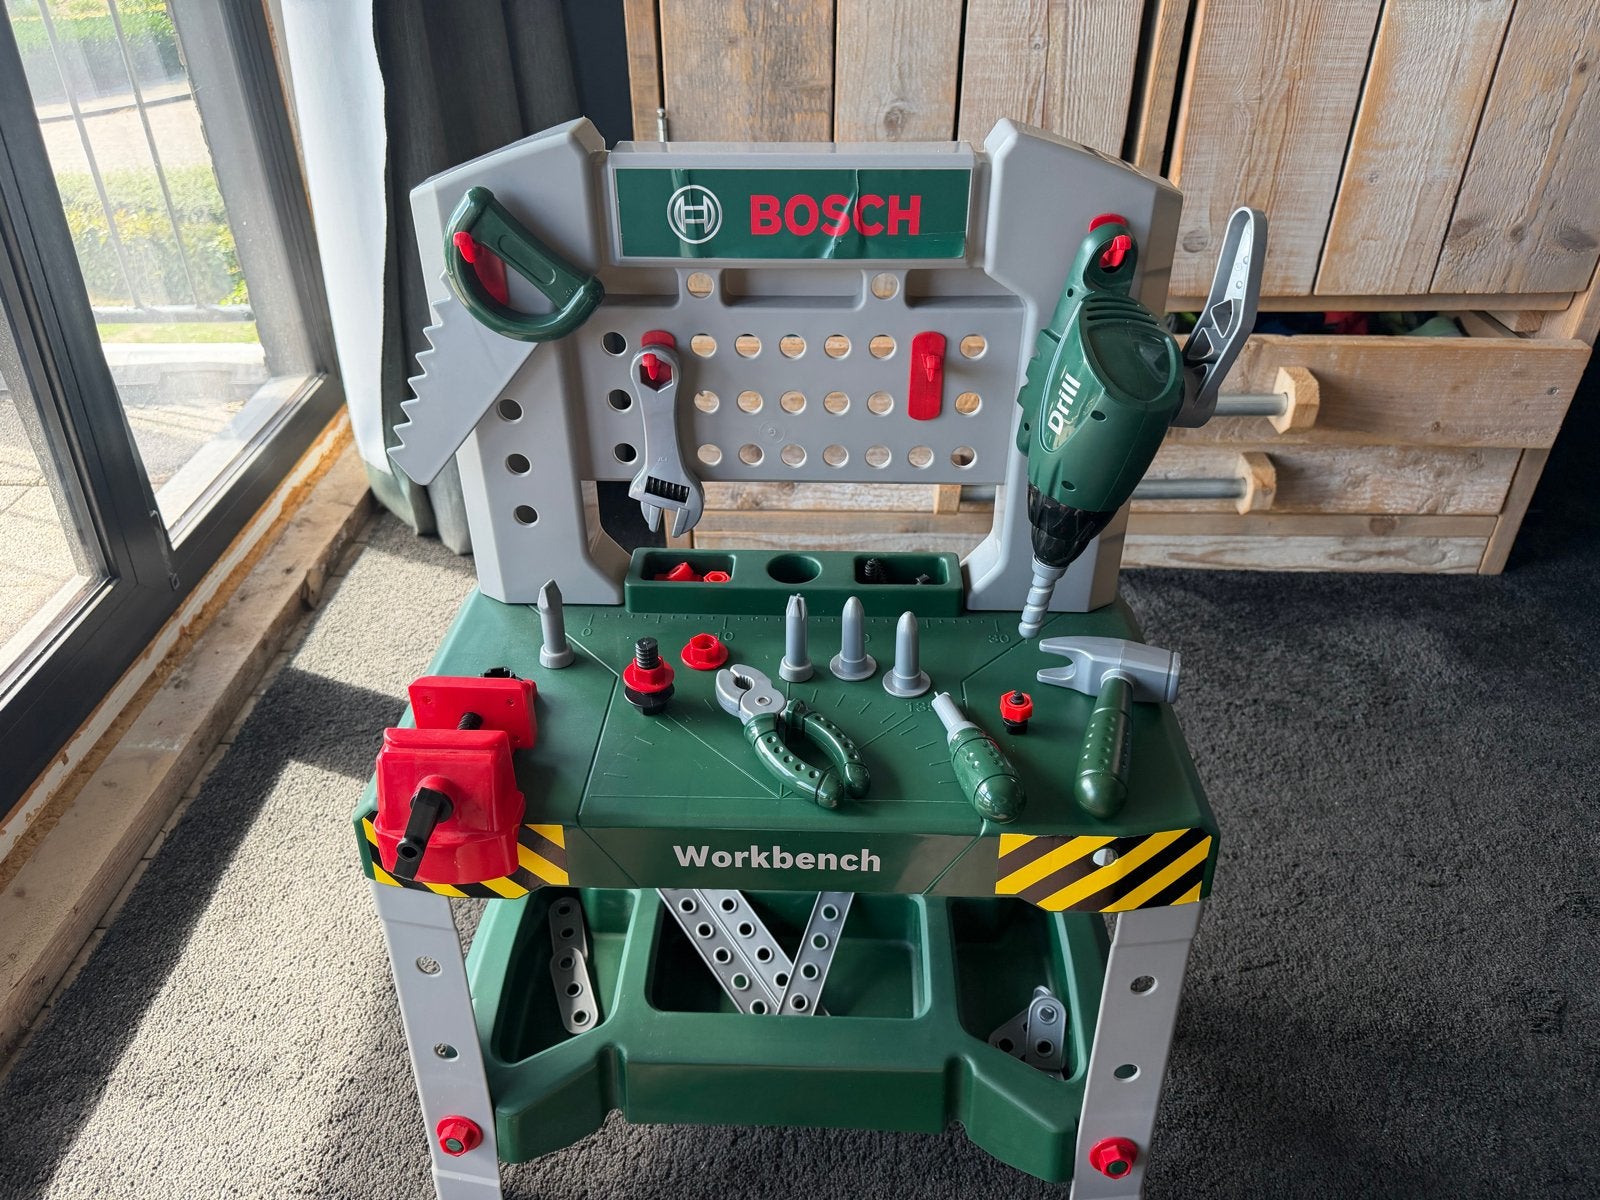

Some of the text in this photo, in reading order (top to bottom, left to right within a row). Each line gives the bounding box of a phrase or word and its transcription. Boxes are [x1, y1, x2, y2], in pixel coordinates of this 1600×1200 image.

[750, 194, 922, 236] BOSCH
[1047, 372, 1081, 436] Drill
[673, 845, 881, 872] Workbench
